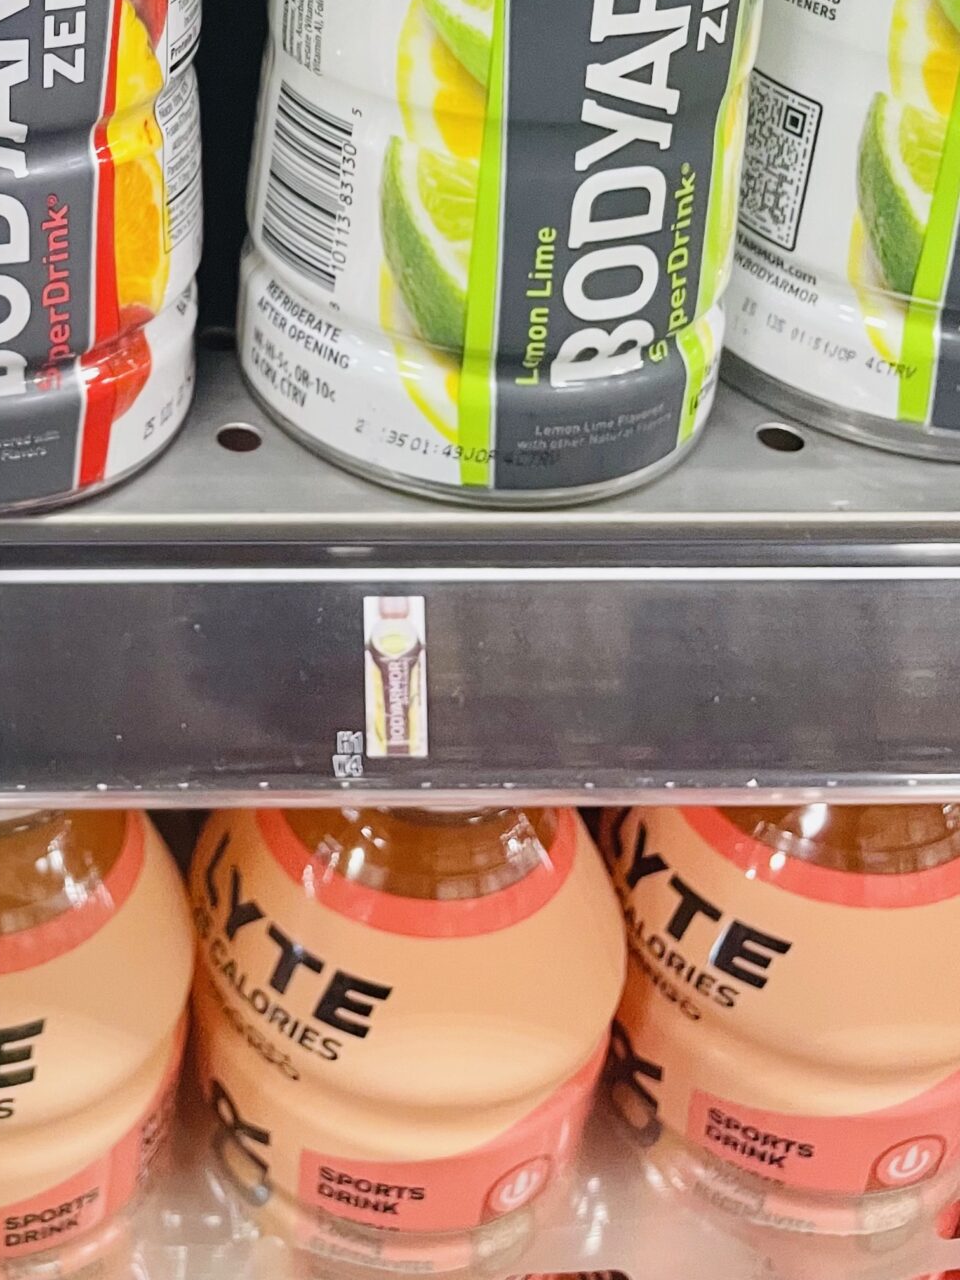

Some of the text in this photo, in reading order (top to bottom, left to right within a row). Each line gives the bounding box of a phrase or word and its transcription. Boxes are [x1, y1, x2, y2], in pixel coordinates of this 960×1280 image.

[525, 227, 557, 307] Lime
[257, 296, 350, 370] AFTER OPENING
[267, 279, 342, 343] REFRIGERATE
[535, 419, 615, 437] Lemon Lime
[205, 832, 393, 1039] LYTE
[209, 937, 343, 1062] CALORIES
[704, 1124, 788, 1169] DRINK
[707, 1107, 815, 1158] SPORTS
[317, 1184, 400, 1215] DRINK
[319, 1165, 425, 1201] SPORTS
[5, 1187, 100, 1231] SPORTS
[5, 1212, 81, 1248] DRINK
